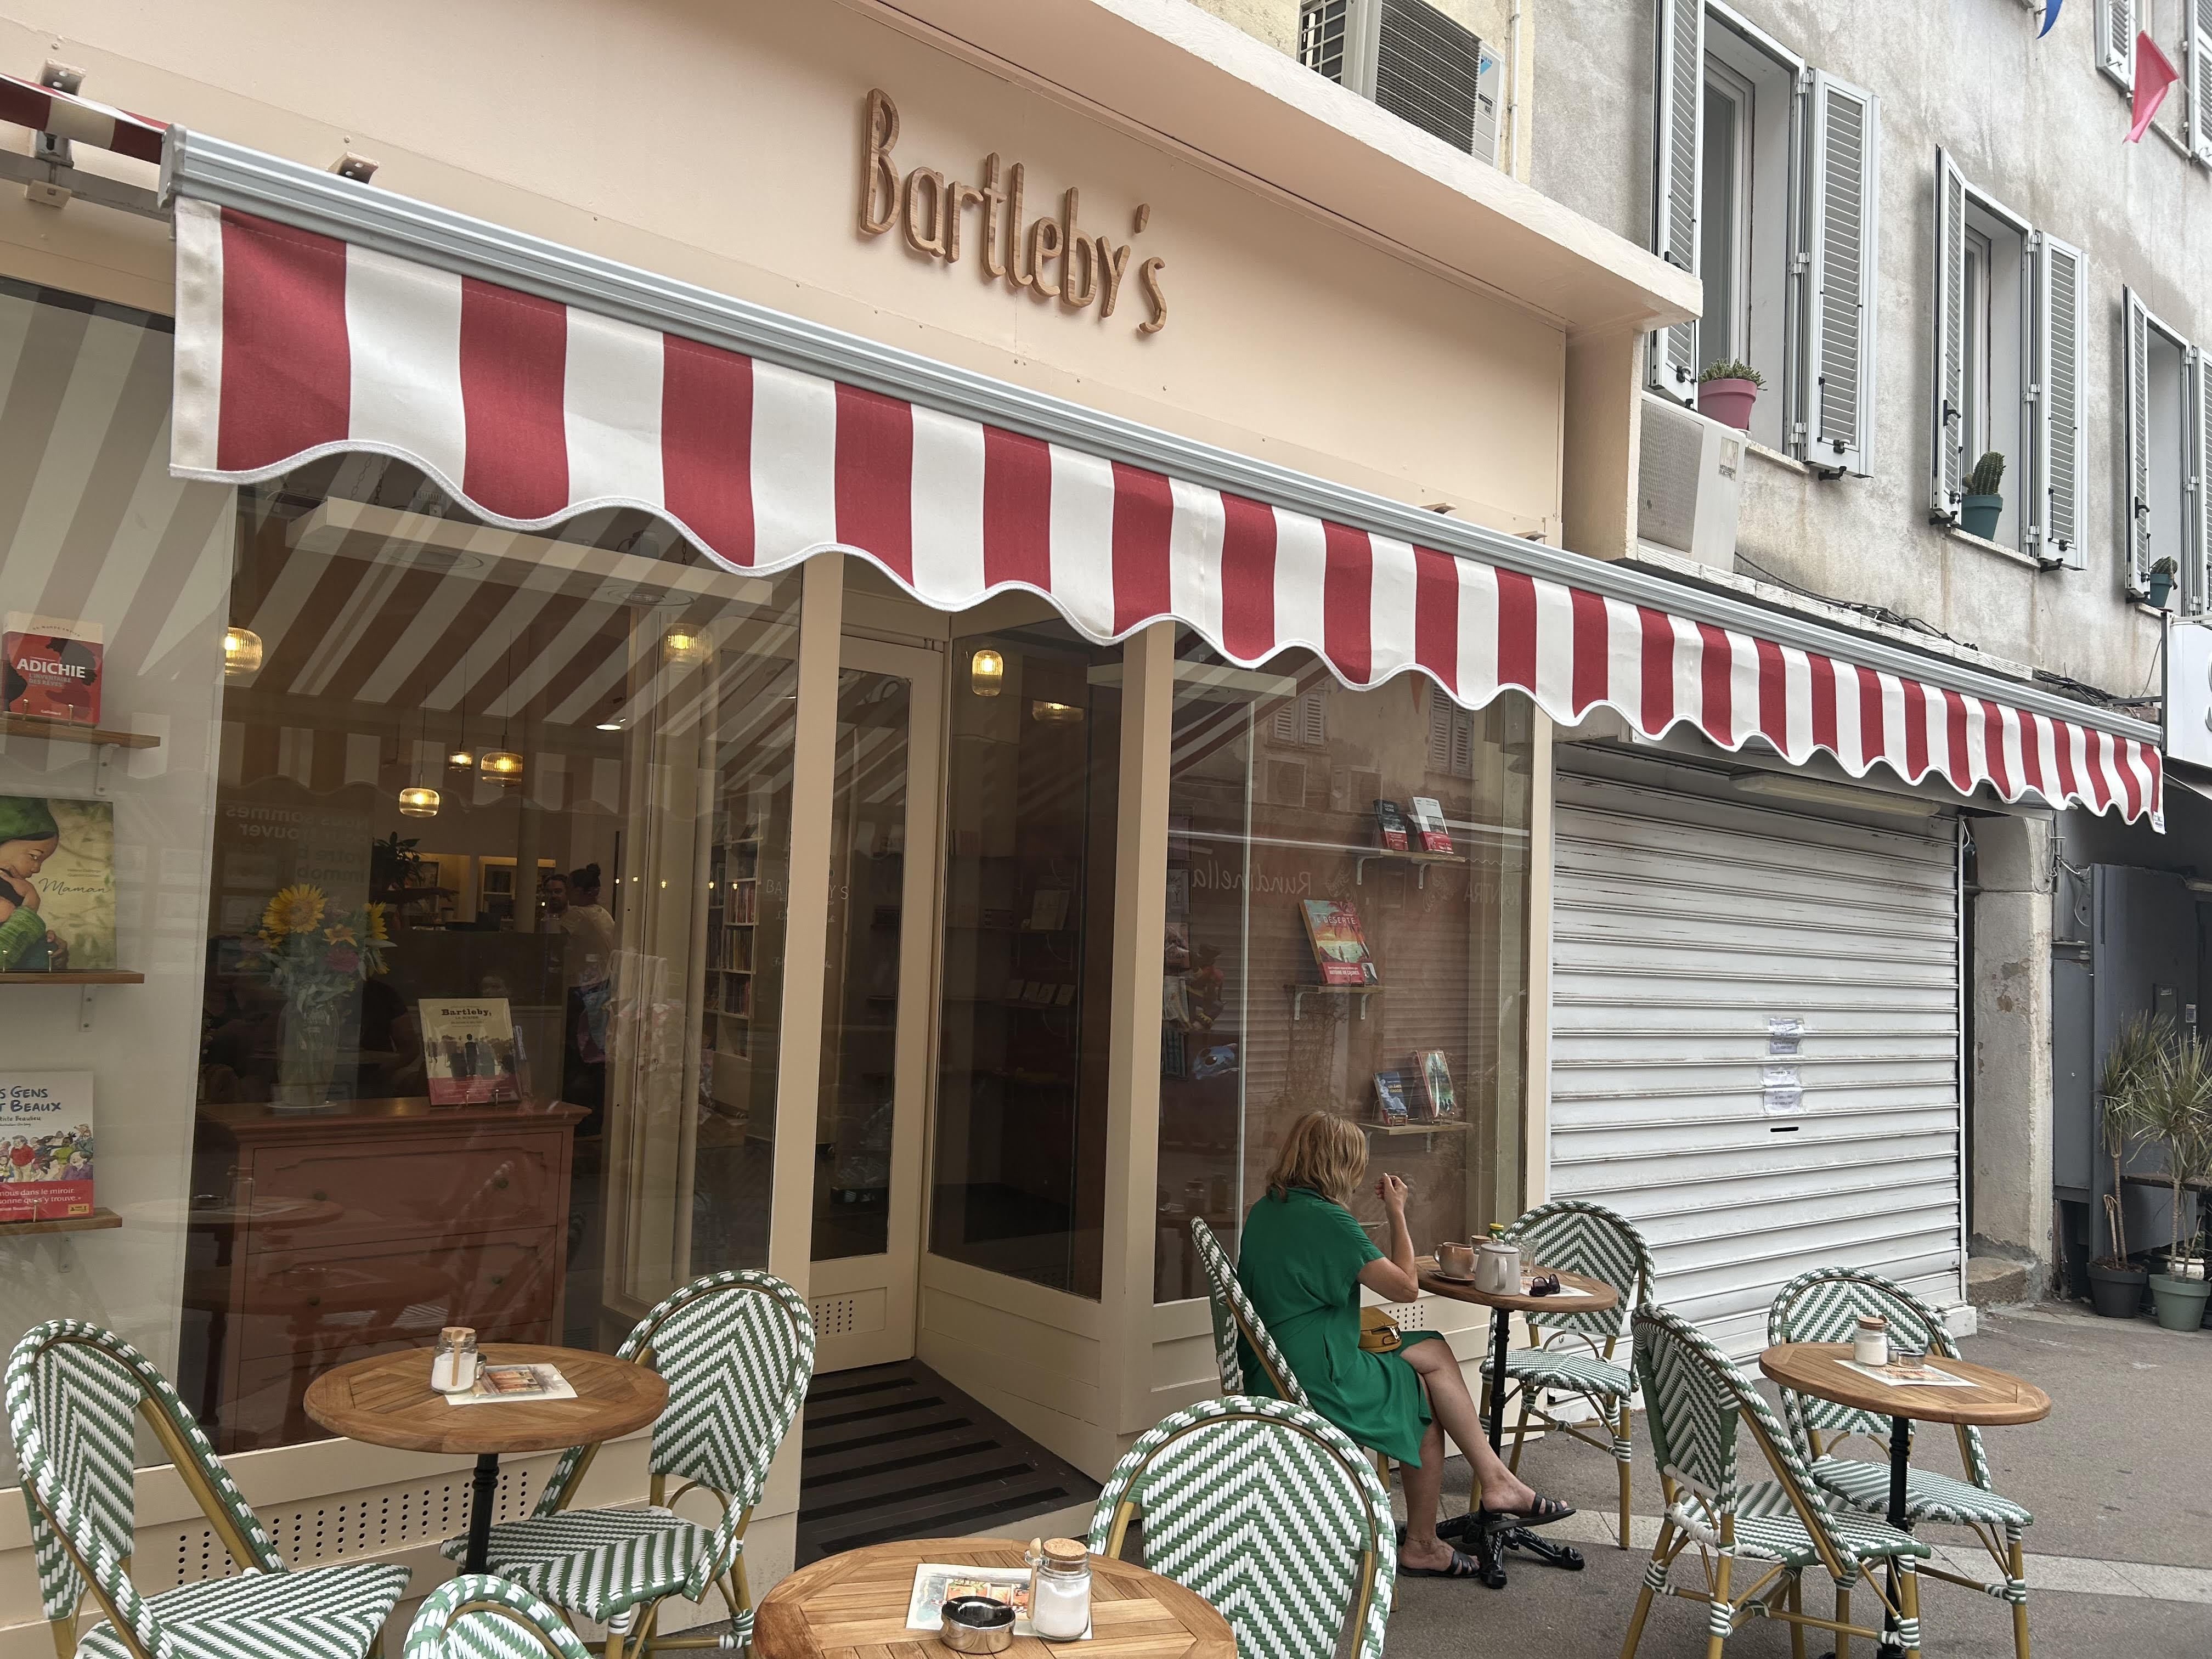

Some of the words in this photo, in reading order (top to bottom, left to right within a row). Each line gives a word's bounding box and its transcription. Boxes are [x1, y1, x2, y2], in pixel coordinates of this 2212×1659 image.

[860, 88, 1167, 333] Bartleby's
[16, 658, 86, 678] ADICHIE
[38, 878, 111, 895] Maman
[1323, 915, 1357, 924] DÉSERTE
[10, 1086, 48, 1098] GENS
[10, 1099, 61, 1112] BEAUX
